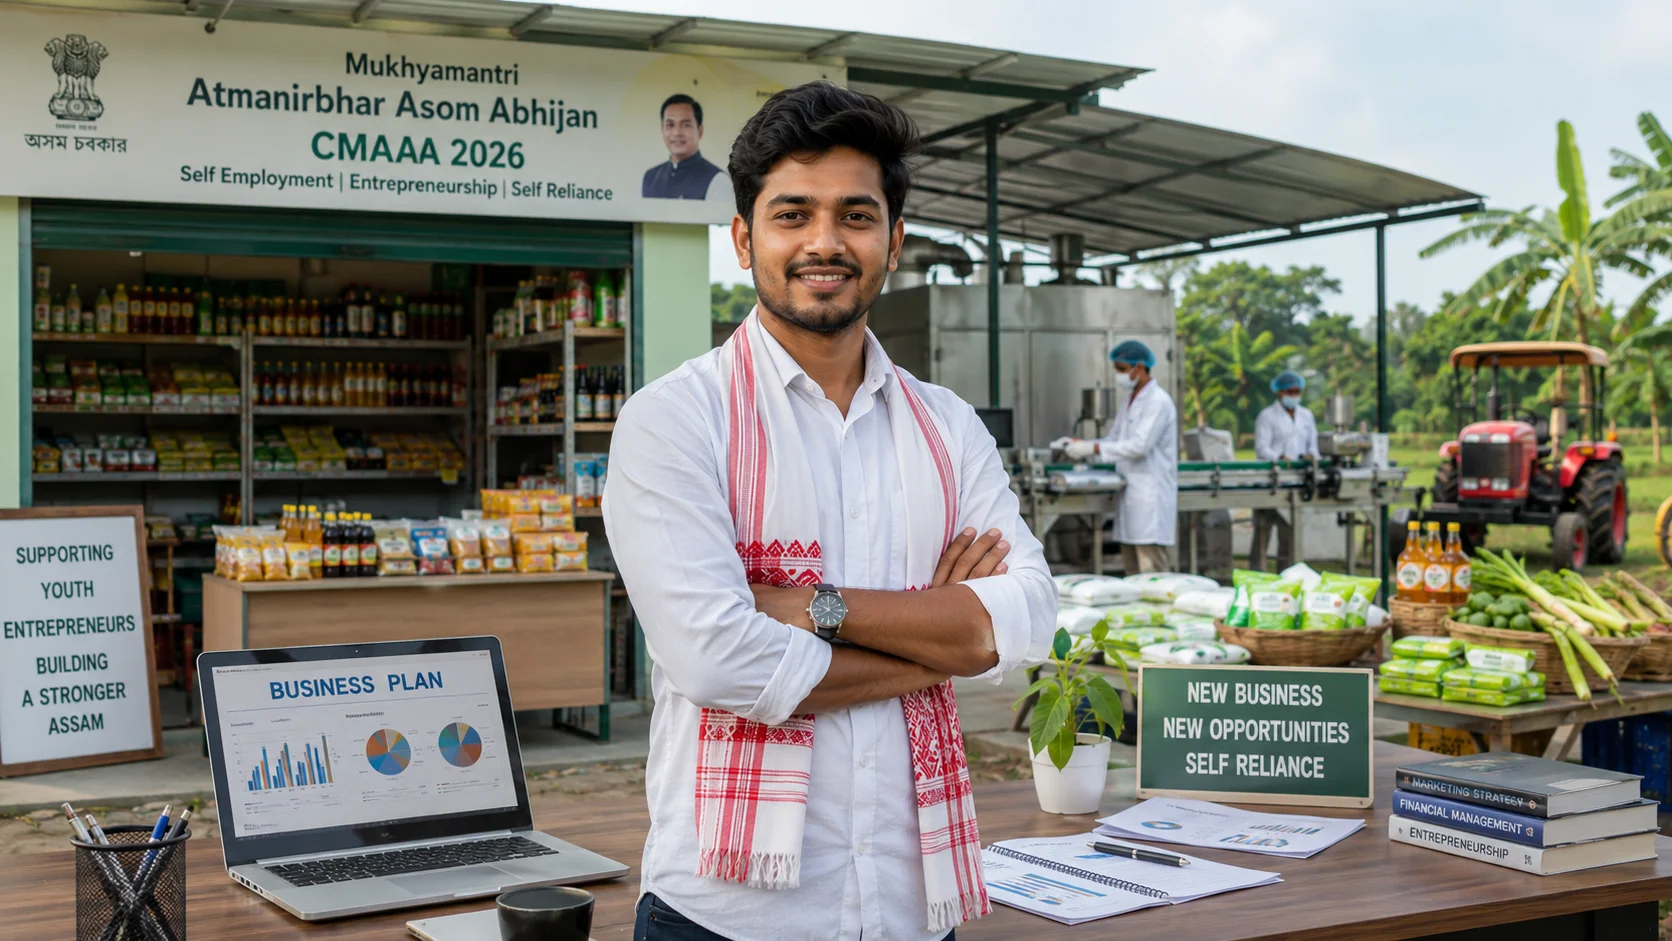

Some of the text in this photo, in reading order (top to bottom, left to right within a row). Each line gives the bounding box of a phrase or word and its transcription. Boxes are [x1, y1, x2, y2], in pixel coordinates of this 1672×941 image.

[345, 52, 519, 85] Mukhyamantri
[187, 78, 598, 134] Atmanirbhar Asom Abhijan
[24, 133, 68, 150] অসম
[311, 131, 525, 169] CMAAA 2026
[180, 165, 216, 183] Self
[221, 167, 334, 190] Employment
[350, 174, 498, 199] Entrepreneurship
[511, 181, 543, 197] Self
[547, 183, 613, 200] Reliance
[16, 544, 114, 565] SUPPORTING
[41, 580, 94, 600] YOUTH
[4, 615, 136, 639] ENTREPRENEURS
[36, 653, 109, 675] BUILDING
[22, 682, 127, 707] A STRONGER
[269, 671, 444, 700] BUSINESS PLAN
[1187, 682, 1323, 707] NEW BUSINESS
[48, 713, 104, 735] ASSAM
[1163, 717, 1350, 744] NEW OPPORTUNITIES
[1185, 752, 1325, 779] SELF RELIANCE
[1412, 777, 1470, 797] MARKETING
[1400, 798, 1523, 835] FINANCIAL MANAGEMENT
[1409, 827, 1509, 859] ENTREPRENEURSHIP
